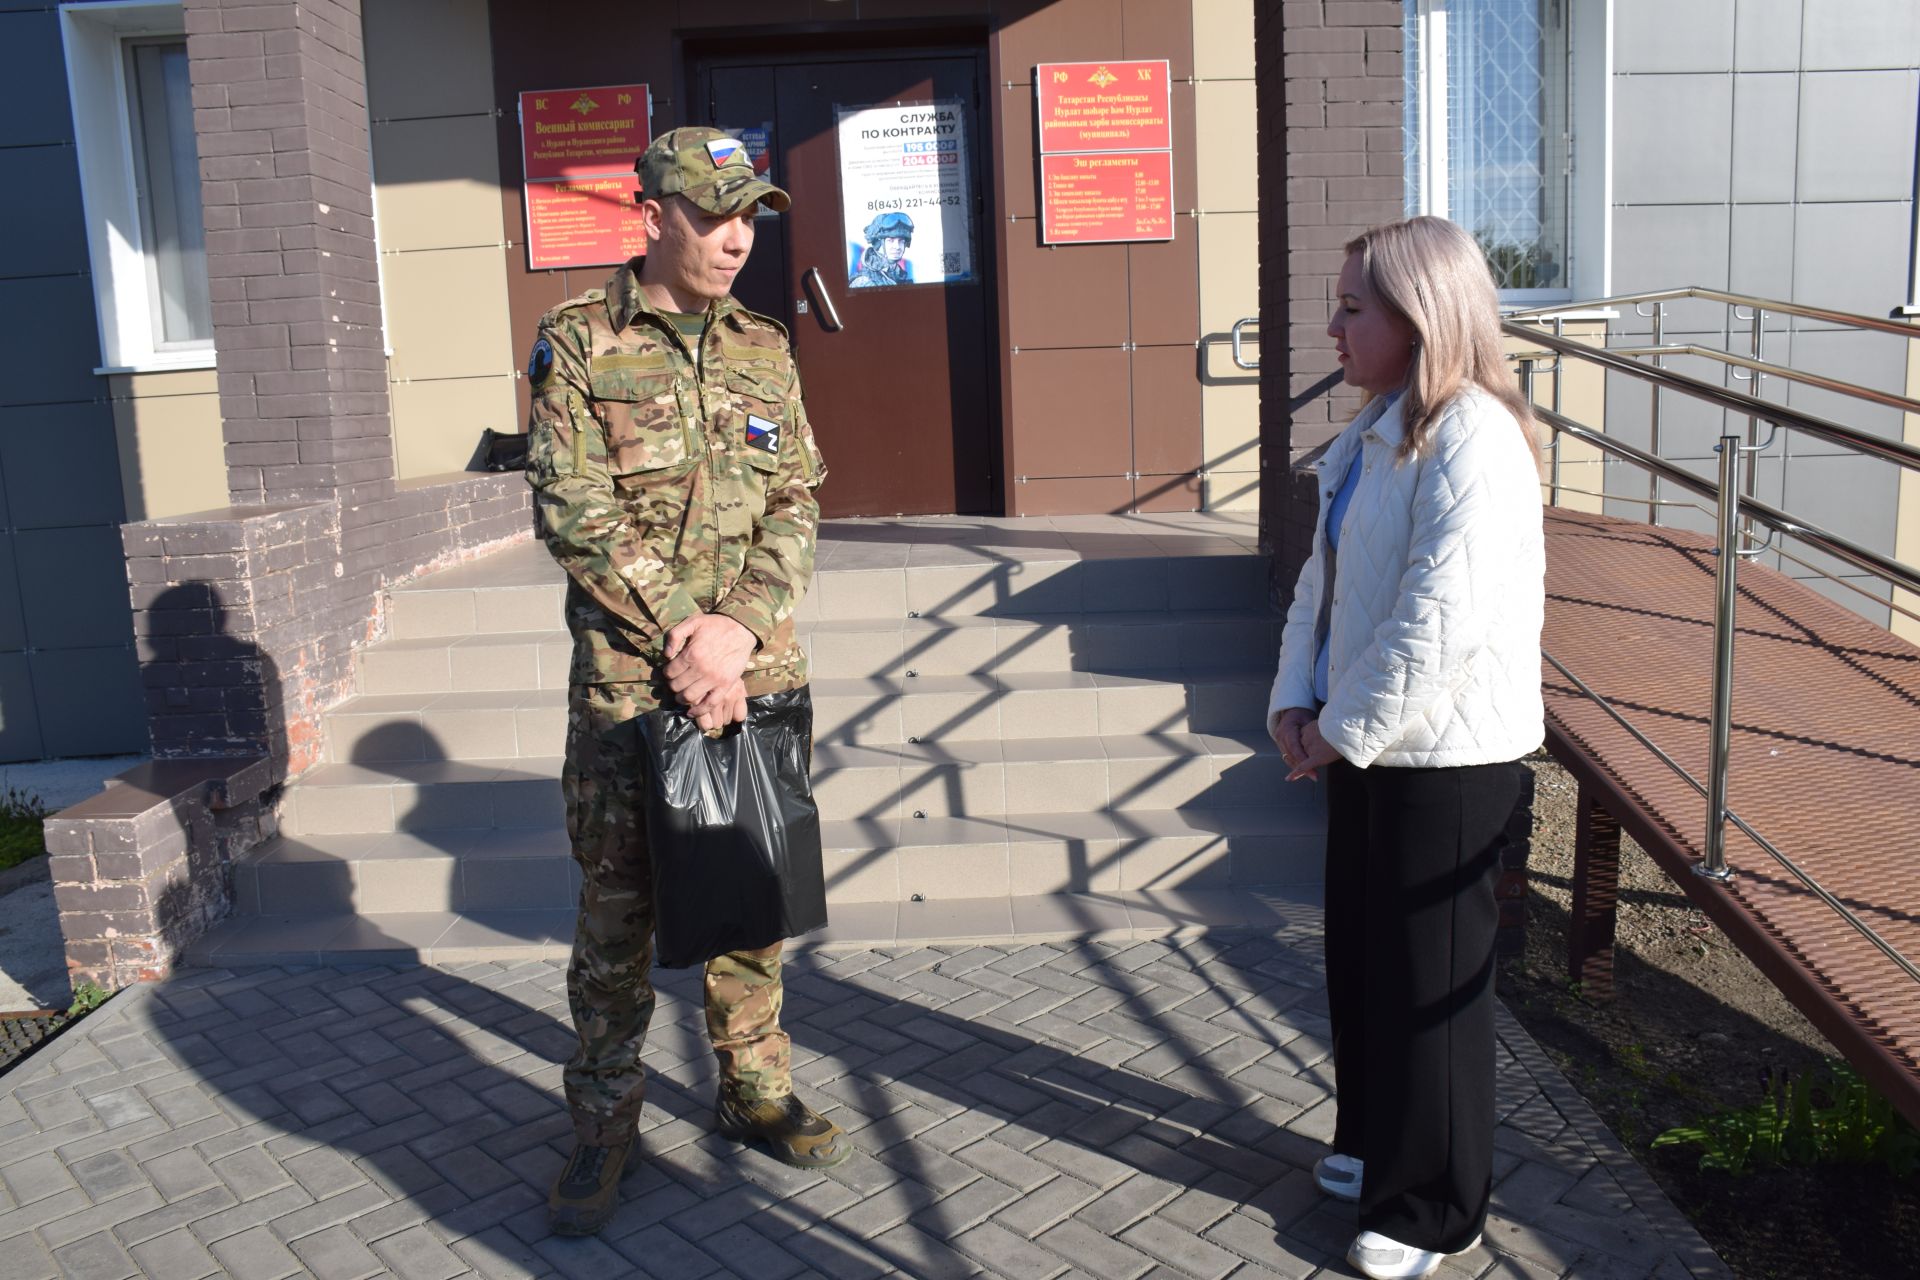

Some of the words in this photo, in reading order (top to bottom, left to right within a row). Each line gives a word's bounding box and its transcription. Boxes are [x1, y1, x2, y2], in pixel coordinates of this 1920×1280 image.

[1053, 71, 1068, 83] РФ
[1137, 69, 1152, 81] ХК
[535, 98, 549, 110] ВС
[617, 93, 632, 105] РФ
[1058, 95, 1096, 107] Татарстан
[1097, 94, 1148, 106] Республикасы
[900, 111, 955, 124] СЛУЖБА
[1054, 107, 1080, 118] Нурлат
[1126, 104, 1152, 116] Нурлат
[535, 120, 576, 134] Военный
[578, 118, 636, 132] комиссариат
[861, 129, 880, 139] ПО
[883, 124, 956, 138] КОНТРАКТУ
[1072, 157, 1087, 168] Эш
[1089, 157, 1138, 169] регламенты
[555, 182, 593, 193] Регламент
[595, 181, 622, 192] работы
[867, 198, 902, 210] 8(843)
[906, 195, 960, 207] 221-44-52
[767, 432, 778, 452] Z
